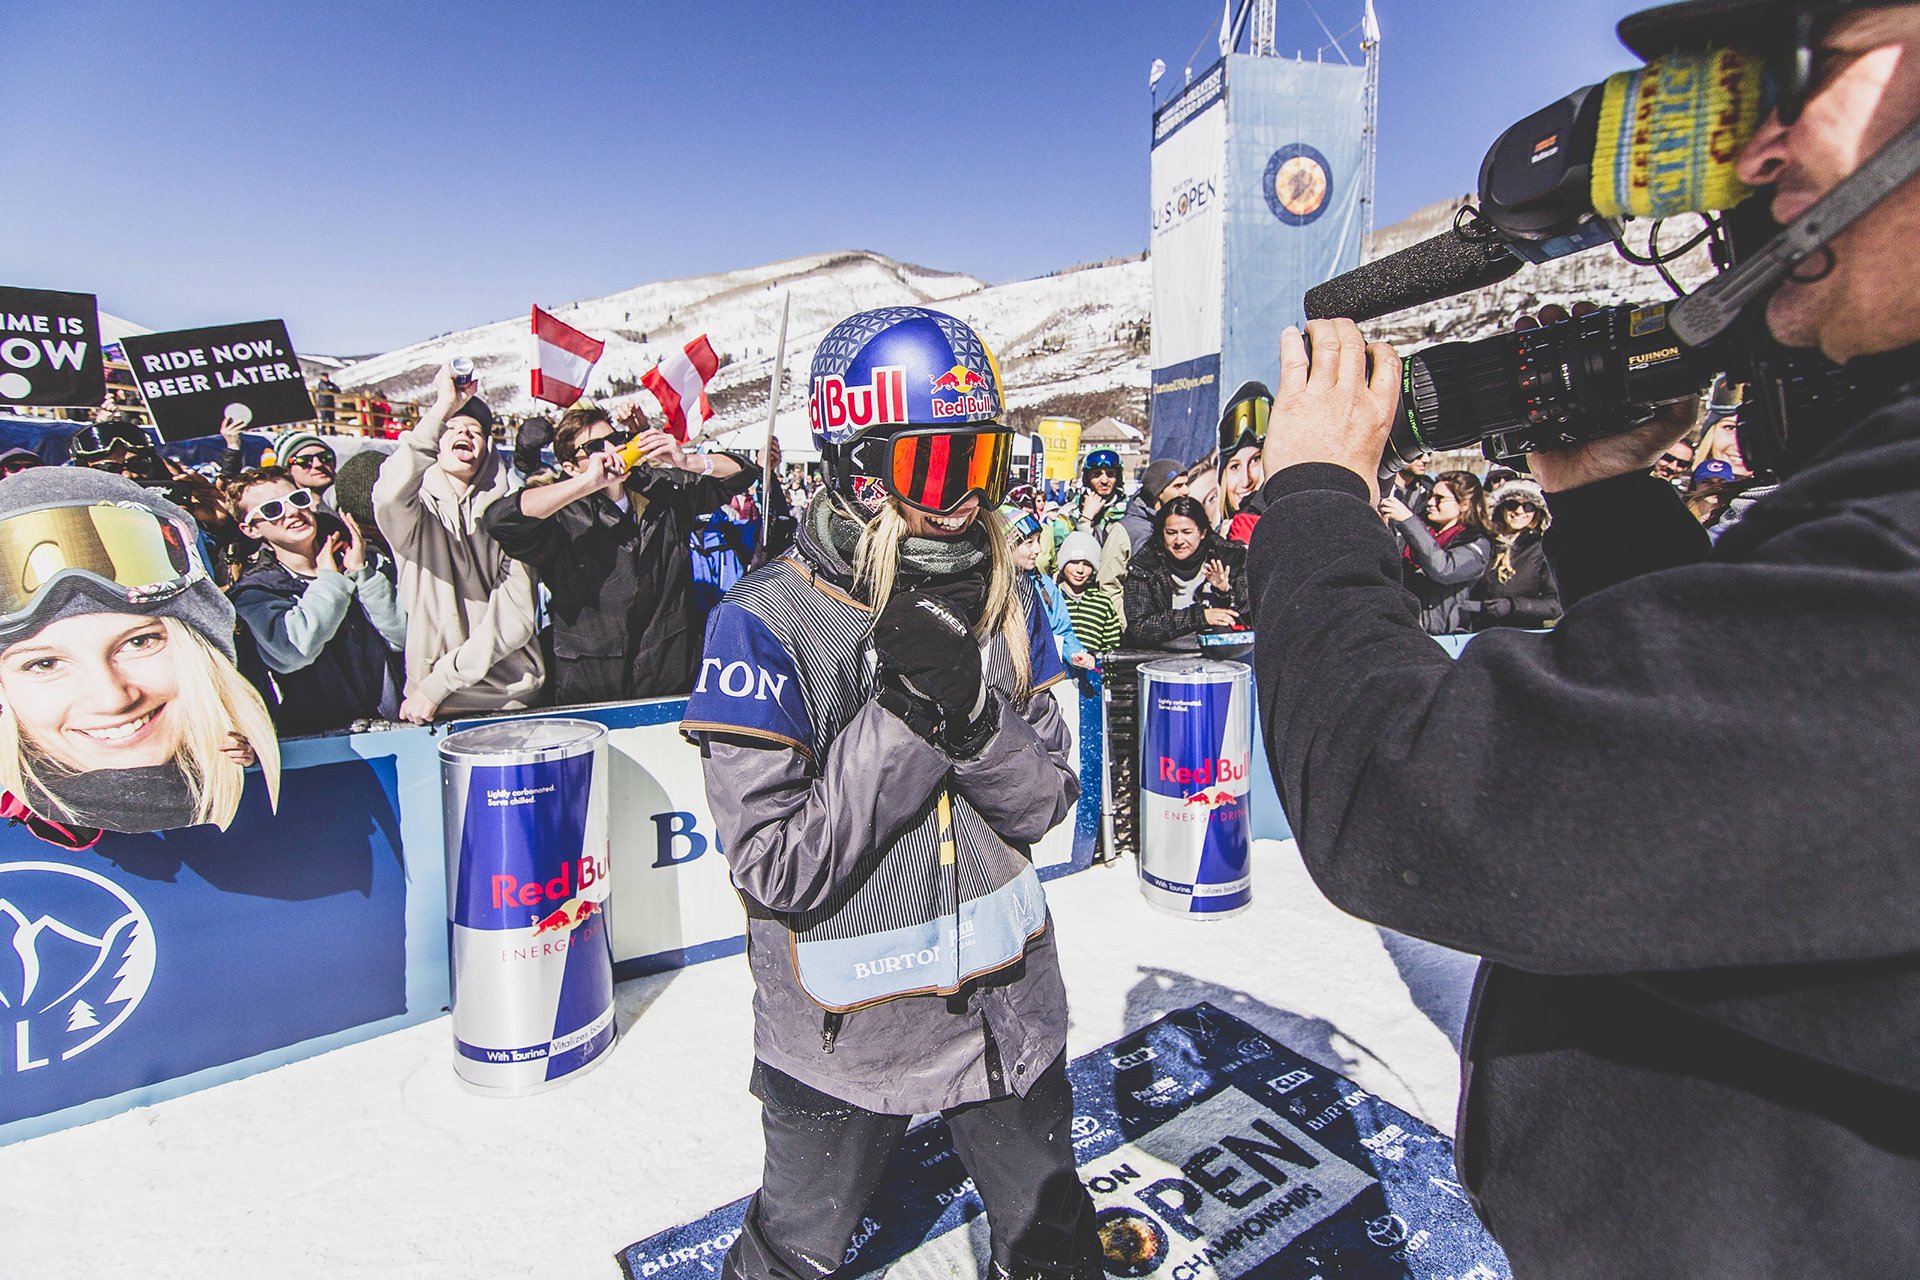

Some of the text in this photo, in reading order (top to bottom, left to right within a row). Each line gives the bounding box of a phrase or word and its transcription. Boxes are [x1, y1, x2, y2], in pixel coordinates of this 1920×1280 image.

[58, 317, 84, 335] IS
[0, 337, 88, 371] OW
[142, 339, 284, 373] RIDE NOW.
[1629, 347, 1679, 364] FUJINON
[142, 363, 301, 399] BEER LATER.
[825, 371, 905, 427] Bull
[934, 396, 990, 416] Red Bull
[695, 657, 789, 709] TON
[1159, 751, 1250, 784] Red Bull
[487, 784, 556, 799] Lightly carbonated.
[487, 795, 536, 807] Serve chilled.
[1164, 809, 1216, 823] ENERGY
[650, 811, 724, 869] B
[491, 861, 570, 910] Red
[1154, 878, 1169, 889] With
[502, 935, 577, 962] ENERGY
[487, 1051, 510, 1062] With
[512, 1049, 547, 1062] Taurine.
[552, 1032, 589, 1051] Vitalizes
[1306, 1090, 1371, 1131] BURTON
[1072, 1128, 1116, 1150] TOYOTA
[1084, 1163, 1142, 1194] ON
[1172, 1183, 1322, 1280] CHAMPIONSHIPS
